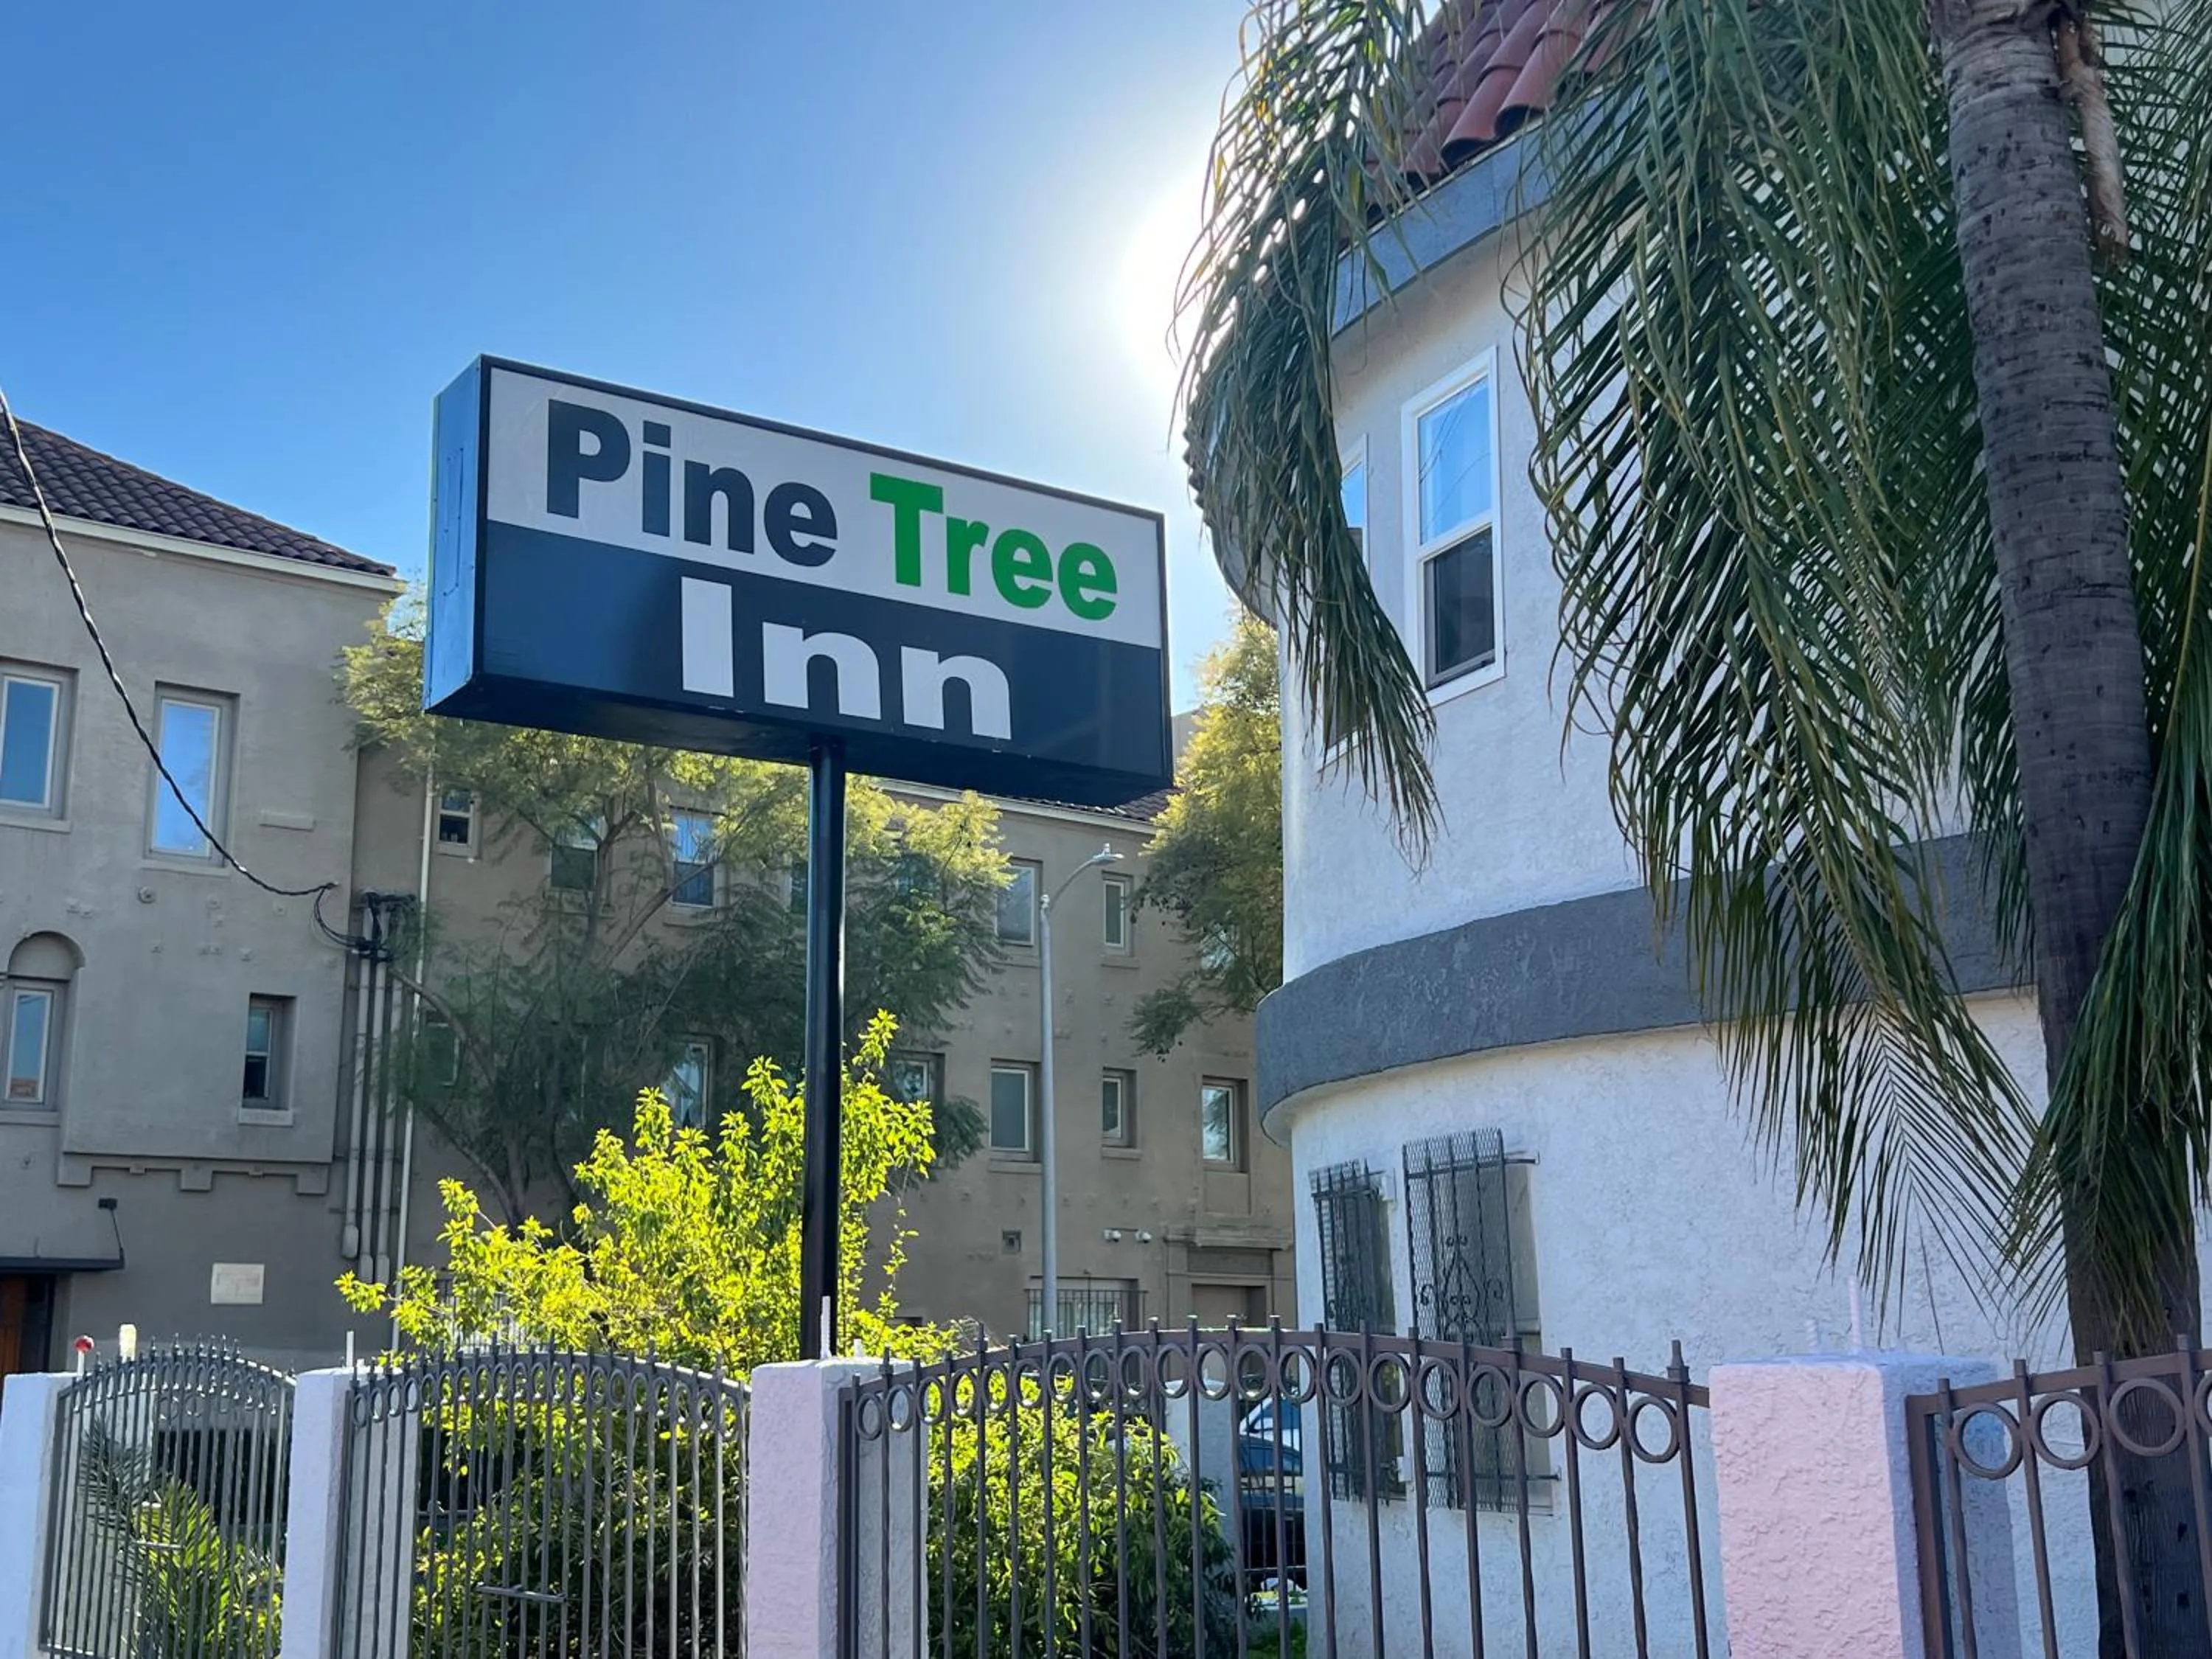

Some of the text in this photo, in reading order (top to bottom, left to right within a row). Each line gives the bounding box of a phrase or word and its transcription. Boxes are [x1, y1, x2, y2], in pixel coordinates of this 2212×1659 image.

[546, 399, 1118, 620] Pine Tree
[681, 576, 1011, 740] Inn
